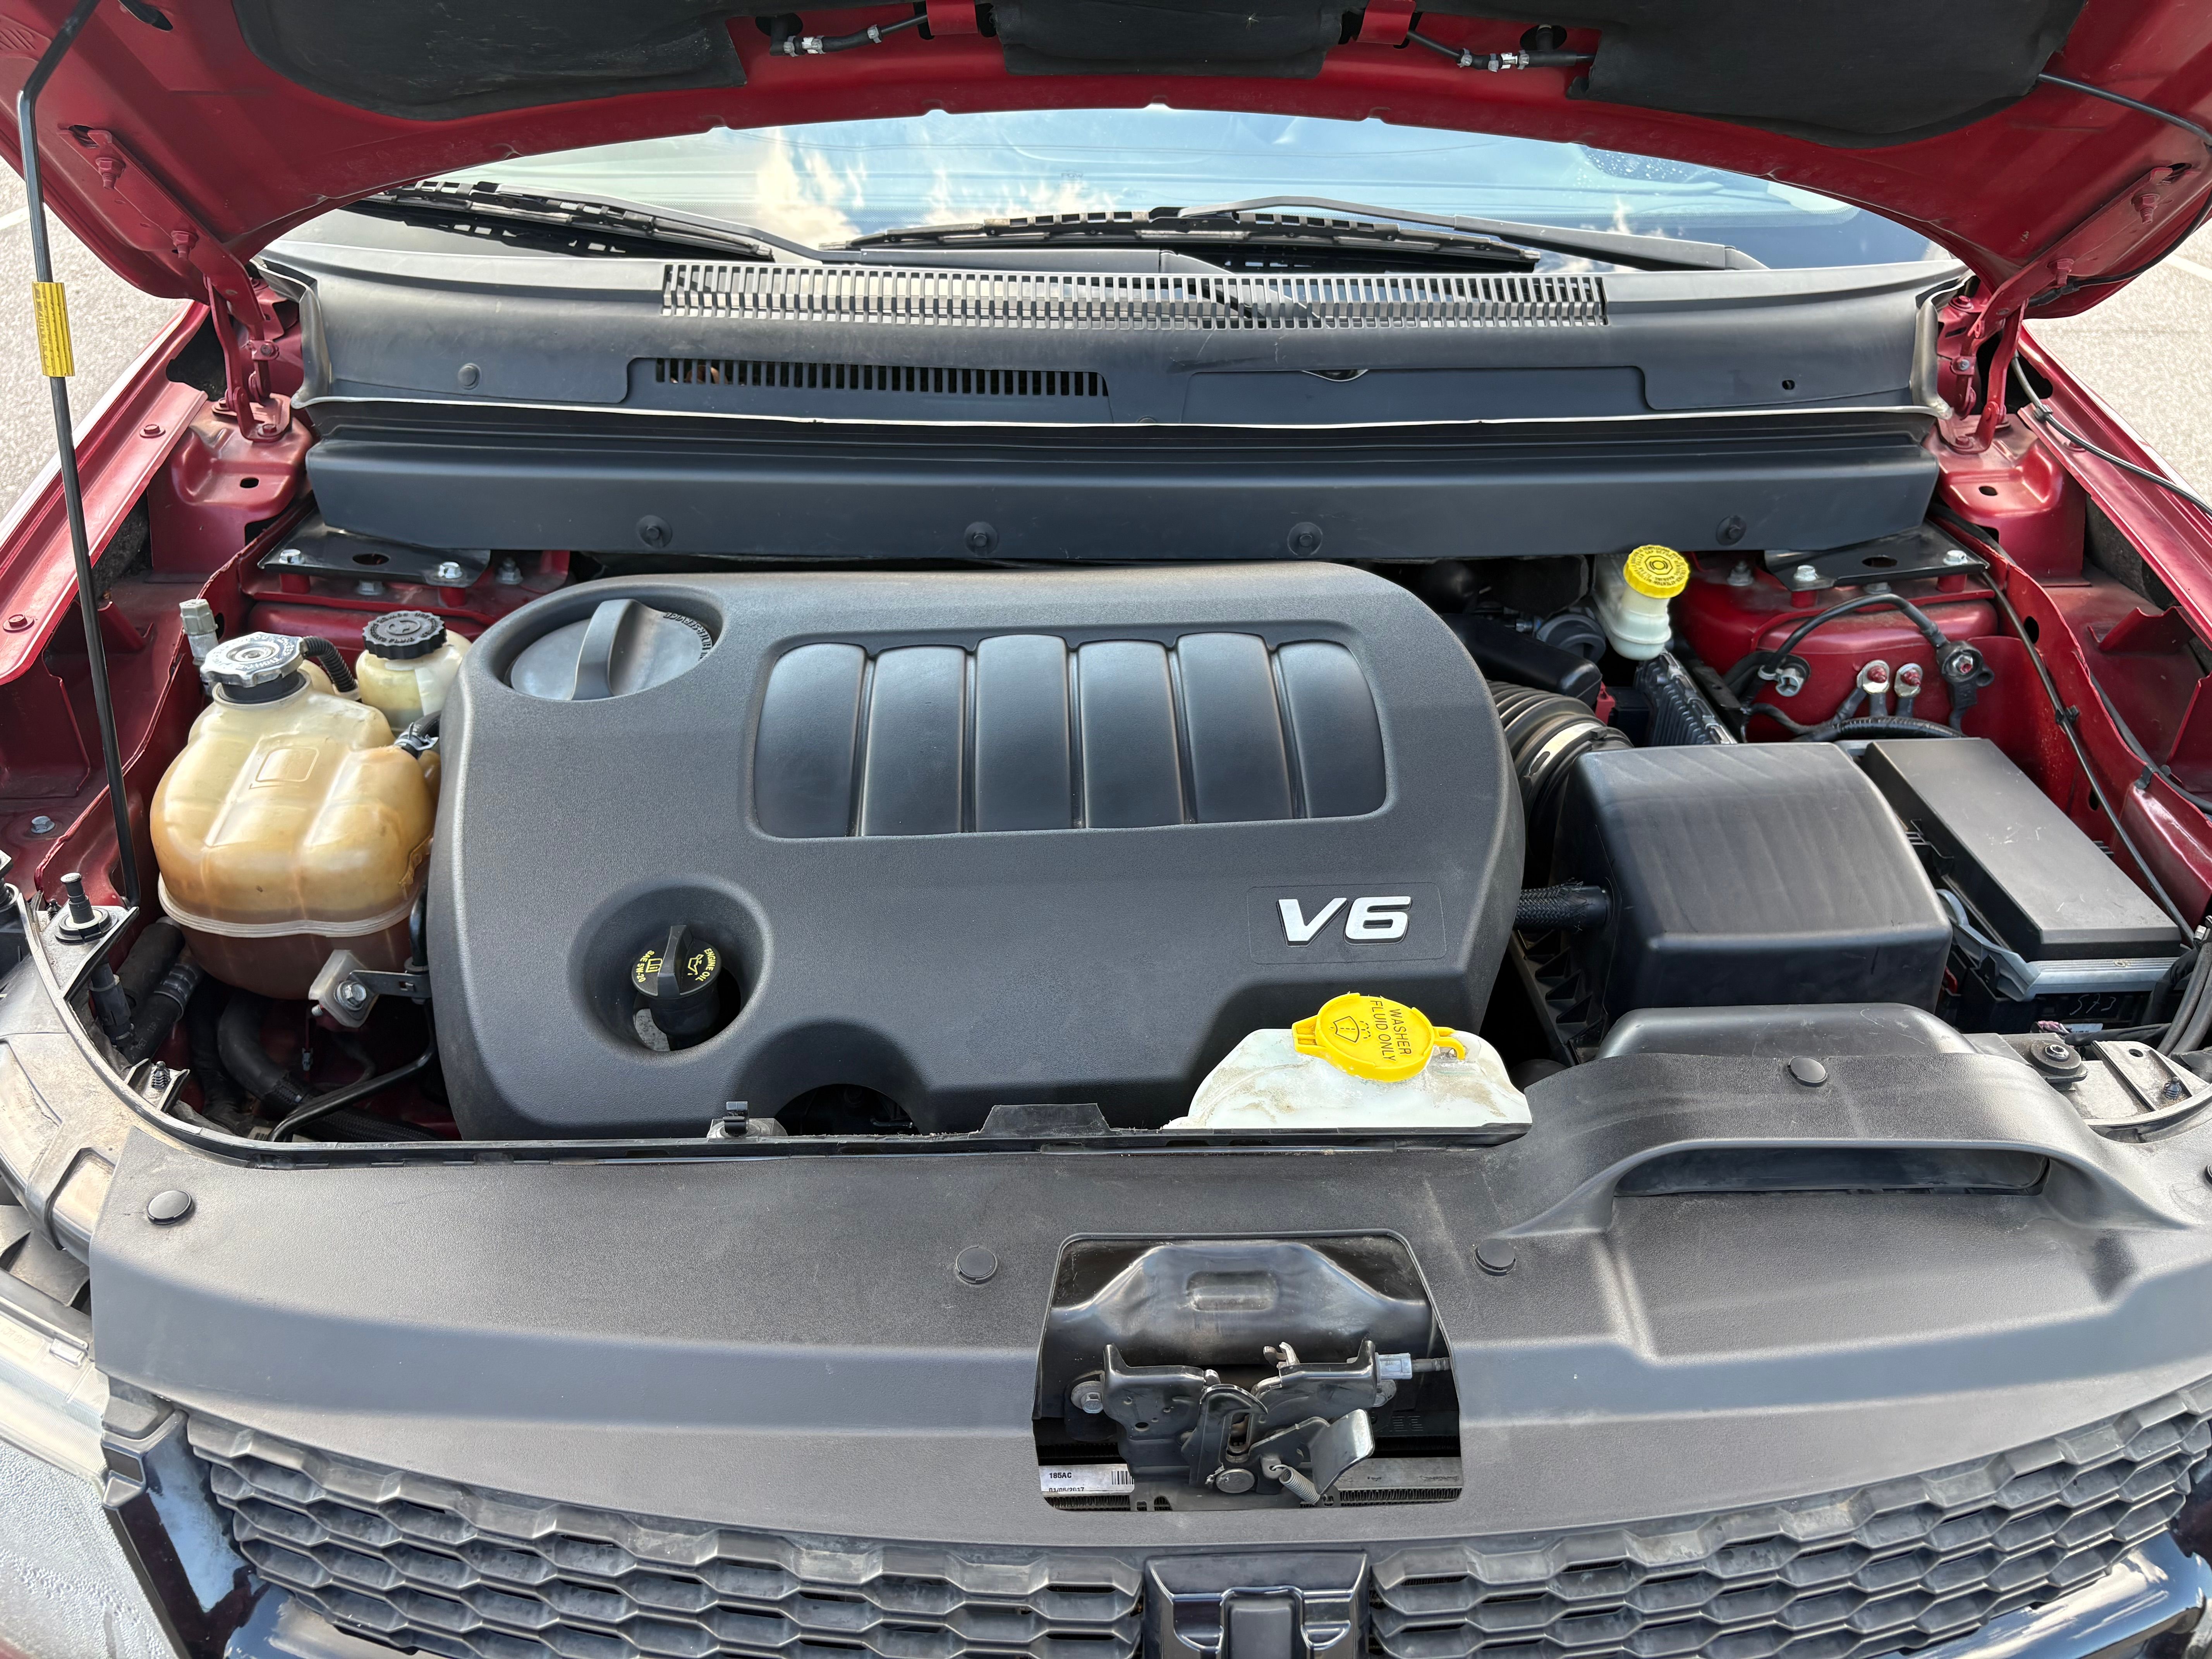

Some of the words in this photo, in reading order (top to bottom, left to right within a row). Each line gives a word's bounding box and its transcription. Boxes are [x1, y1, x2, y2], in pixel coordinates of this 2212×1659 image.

[663, 612, 701, 630] SERVICE
[1278, 896, 1411, 944] V6
[640, 950, 655, 962] SAE
[704, 948, 716, 971] ENGINE
[636, 963, 646, 983] 5W-20
[695, 971, 710, 981] OIL
[1370, 1000, 1388, 1030] FLUID
[1389, 1009, 1412, 1054] WASHER
[1378, 1034, 1396, 1061] ONLY
